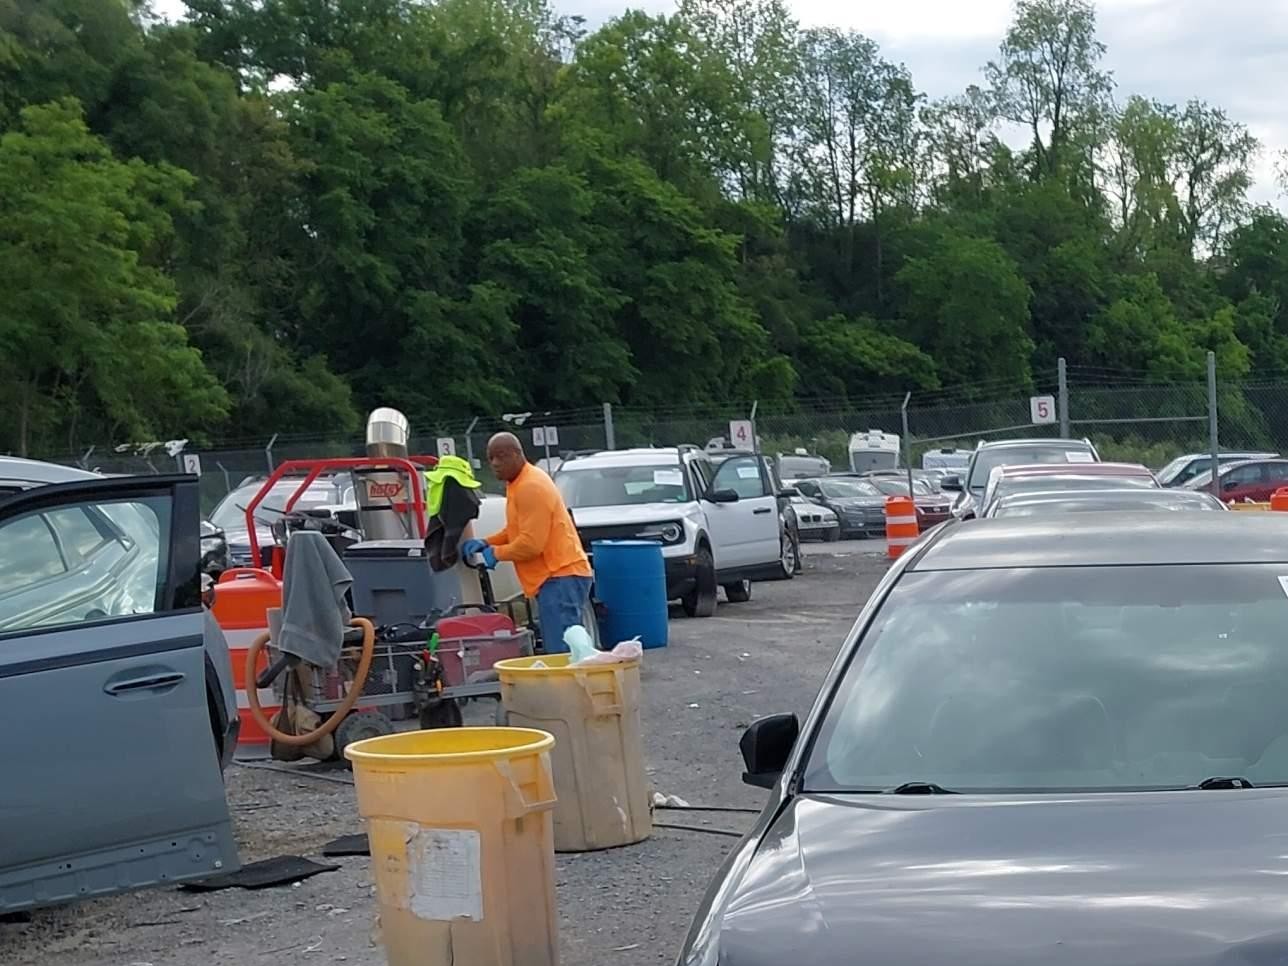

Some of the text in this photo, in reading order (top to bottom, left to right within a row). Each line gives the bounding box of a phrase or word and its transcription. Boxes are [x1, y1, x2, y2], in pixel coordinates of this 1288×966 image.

[1037, 401, 1049, 418] 5
[736, 425, 747, 441] 4
[442, 442, 451, 455] 3
[188, 459, 197, 472] 2
